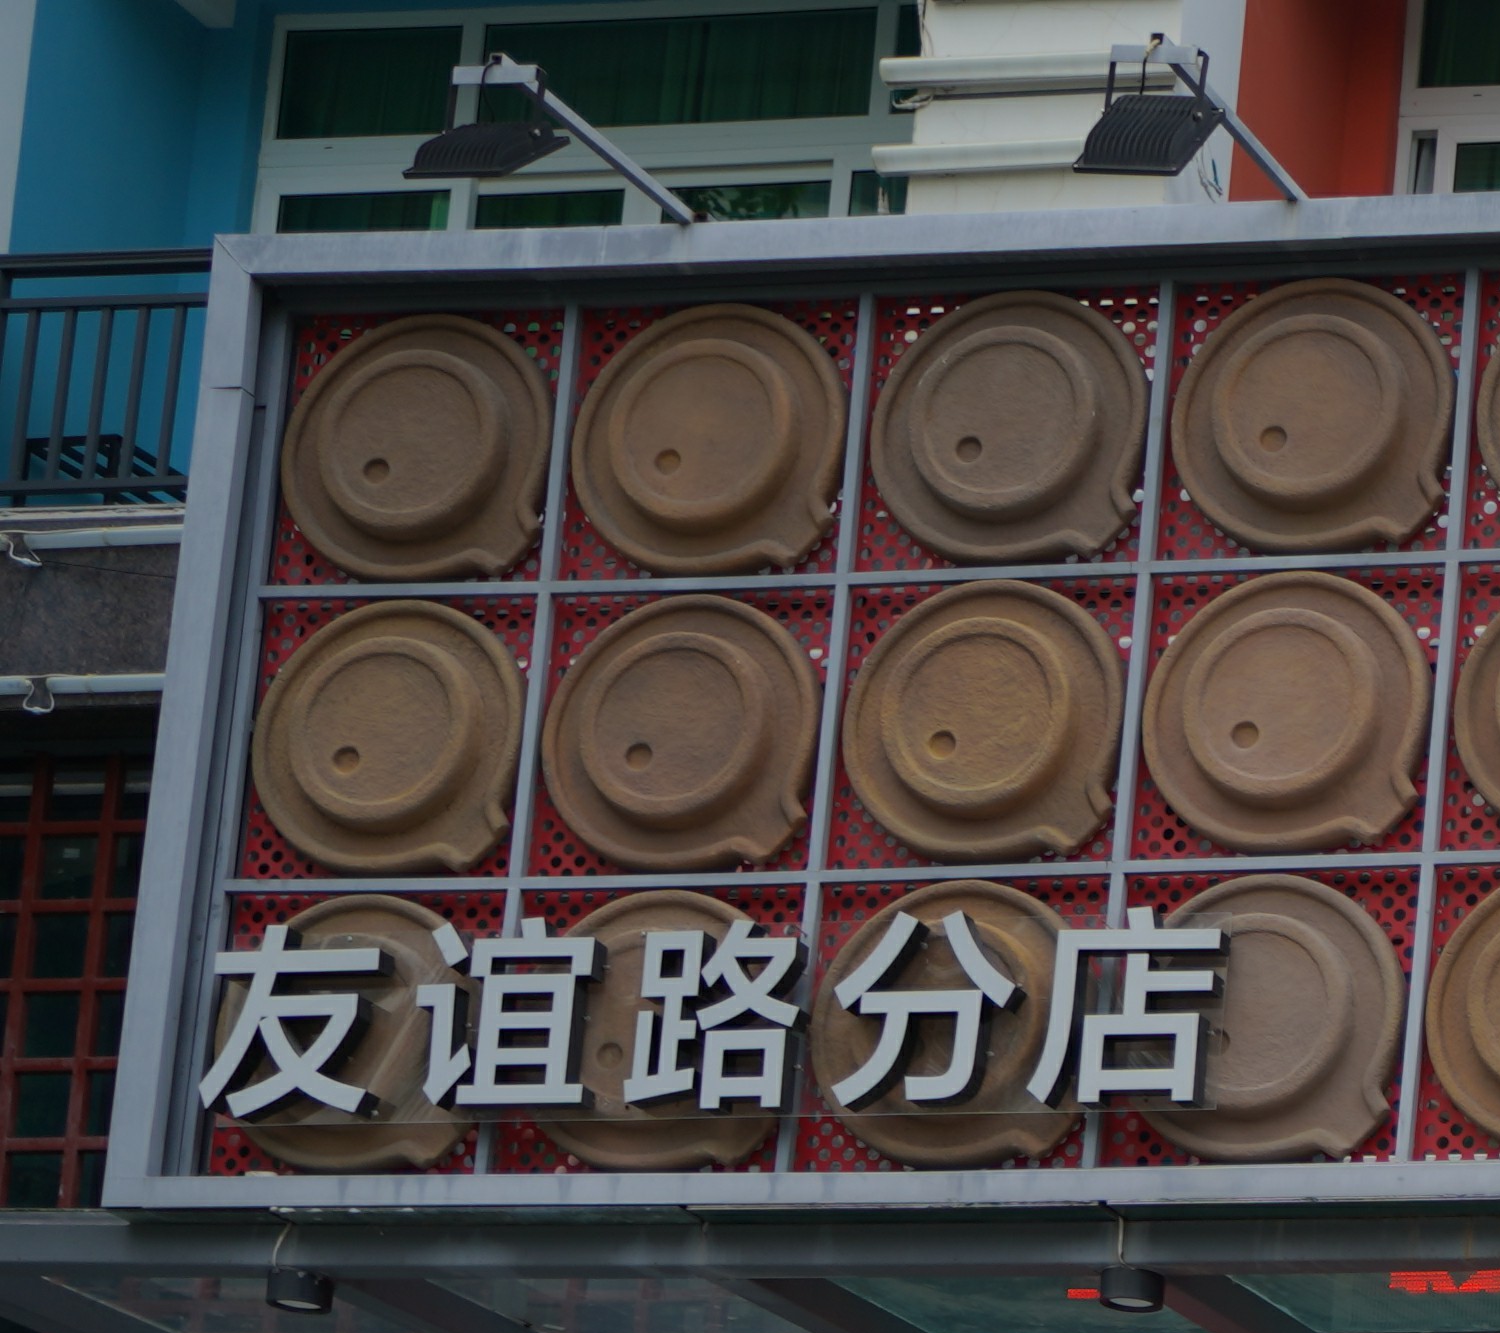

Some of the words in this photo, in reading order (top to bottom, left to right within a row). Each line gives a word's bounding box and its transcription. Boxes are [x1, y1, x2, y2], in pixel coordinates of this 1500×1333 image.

[198, 907, 1228, 1120] 友谊路分店
